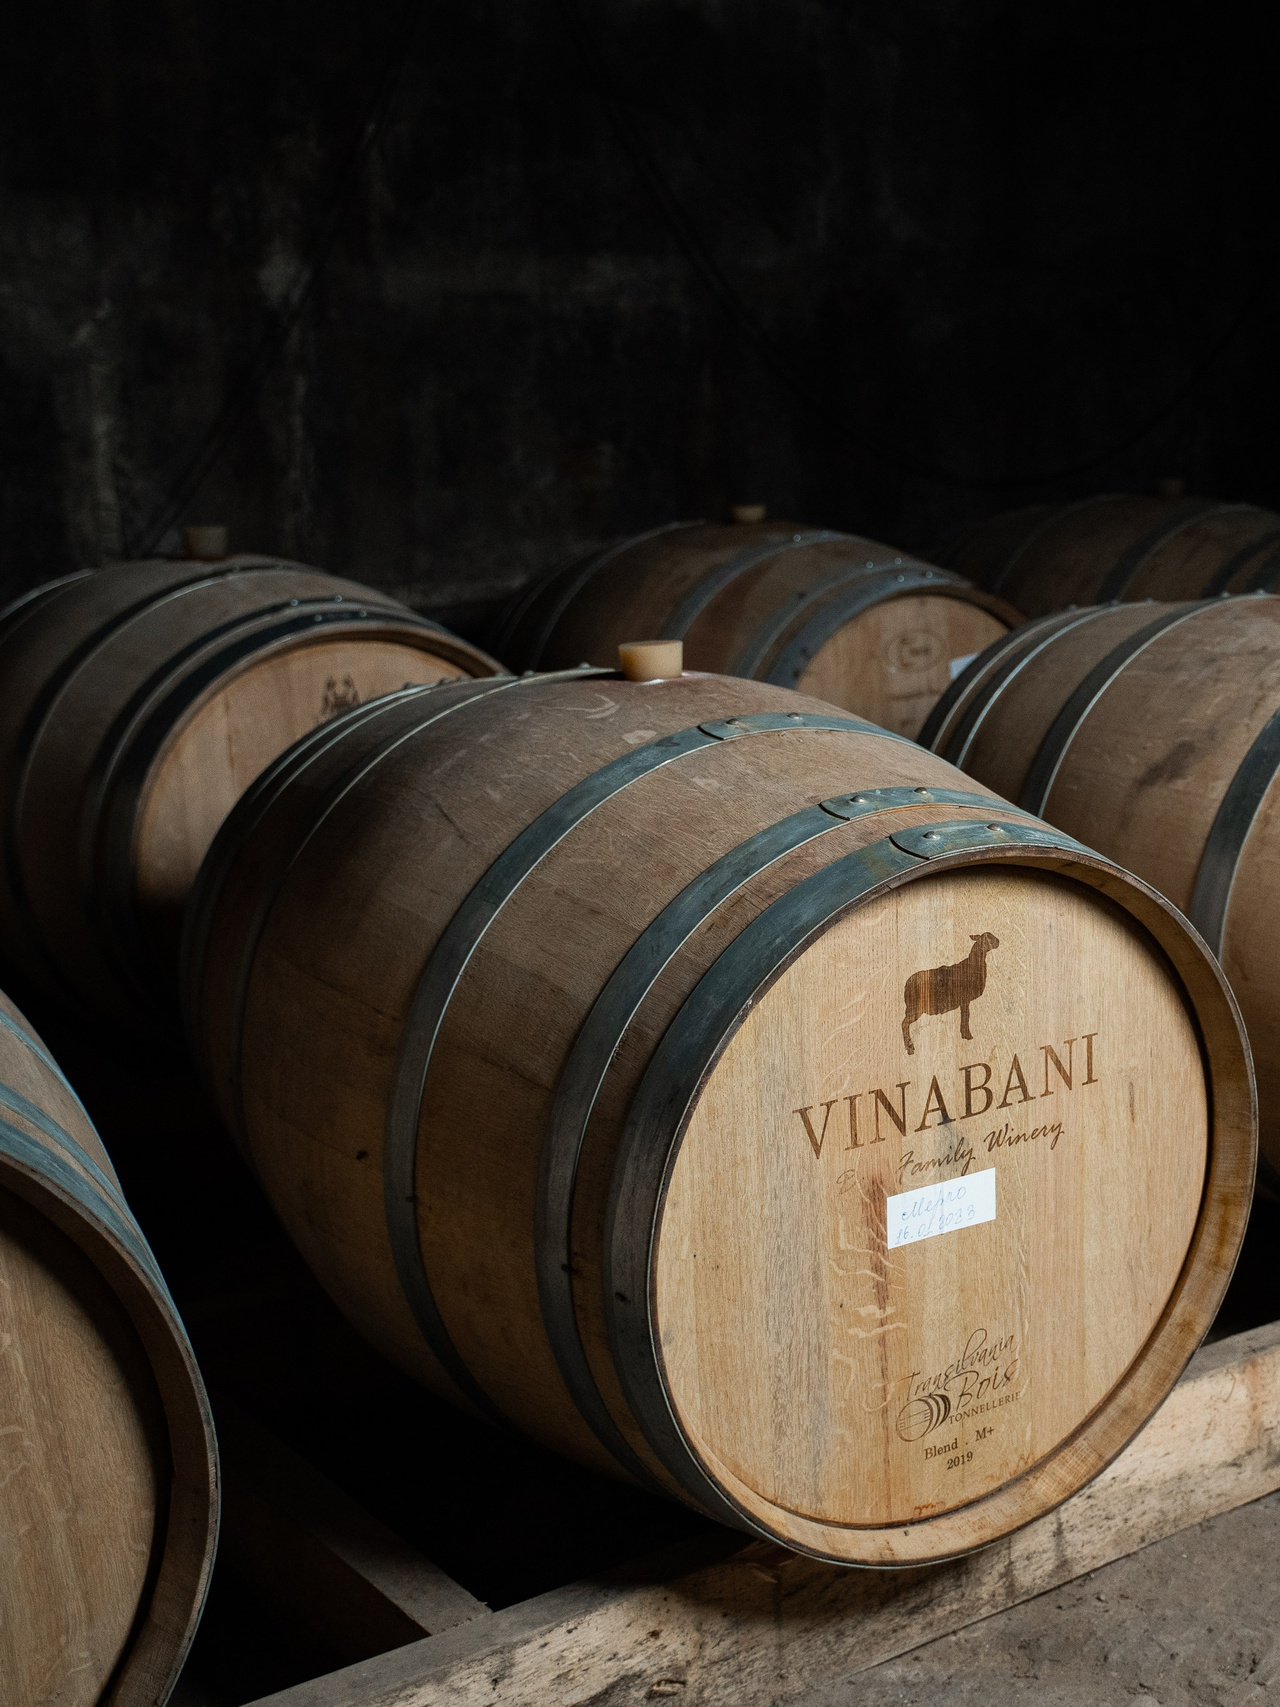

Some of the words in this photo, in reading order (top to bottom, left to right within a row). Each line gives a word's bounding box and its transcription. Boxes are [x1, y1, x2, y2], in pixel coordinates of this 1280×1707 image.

[792, 1032, 1099, 1160] VINABANI
[895, 1137, 976, 1184] Family
[983, 1119, 1066, 1152] Winery
[945, 1358, 1019, 1411] Bois
[948, 1391, 1022, 1425] TONNELLERIE
[924, 1438, 958, 1461] Blend
[975, 1426, 995, 1442] M+
[946, 1451, 973, 1470] 2019
